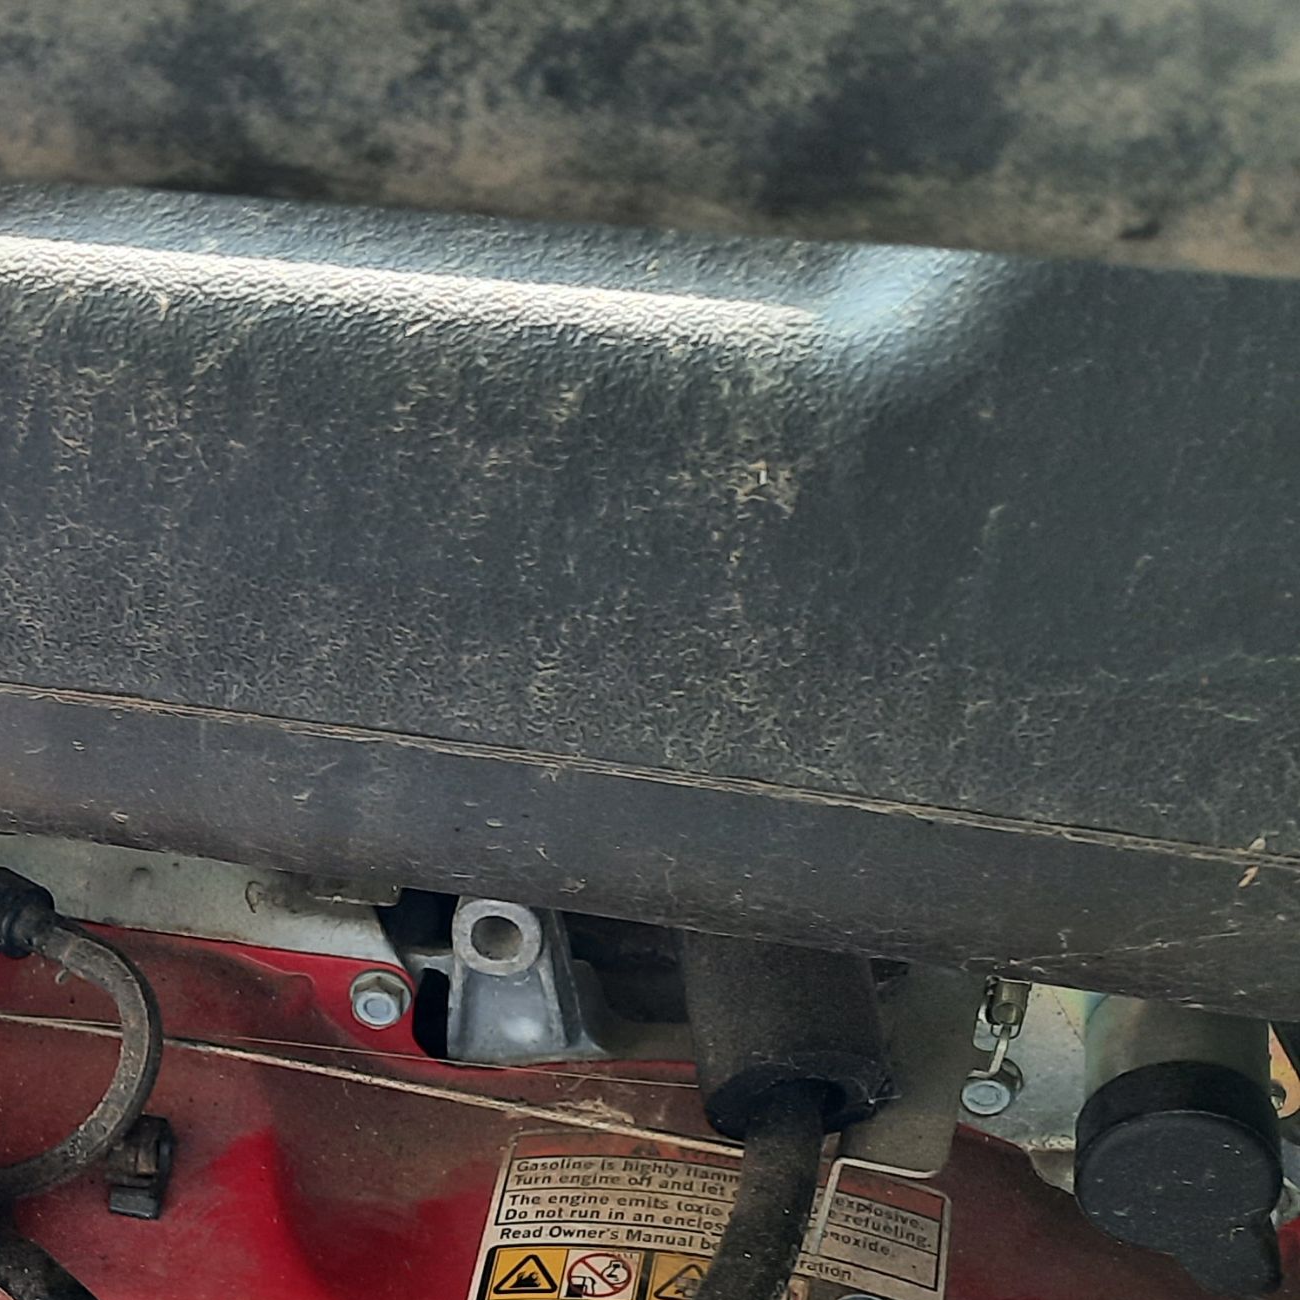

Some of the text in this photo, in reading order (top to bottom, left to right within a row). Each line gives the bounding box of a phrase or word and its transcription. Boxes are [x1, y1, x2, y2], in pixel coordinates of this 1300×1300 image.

[505, 1208, 727, 1231] Do not run in an enclos
[509, 1193, 895, 1257] The engine emits toxic onoxide.
[514, 1174, 551, 1184] Turn
[559, 1174, 619, 1187] engine
[628, 1175, 652, 1187] off
[658, 1177, 693, 1192] and
[701, 1182, 725, 1196] let
[844, 1213, 931, 1249] refueling.
[517, 1160, 594, 1172] Gasoline
[601, 1160, 614, 1171] is
[622, 1160, 678, 1179] highly
[686, 1165, 741, 1183] flamm
[835, 1196, 924, 1231] explosive.
[500, 1226, 542, 1240] Read
[548, 1225, 619, 1240] Owner's
[626, 1230, 693, 1247] Manual
[800, 1259, 856, 1282] ration.
